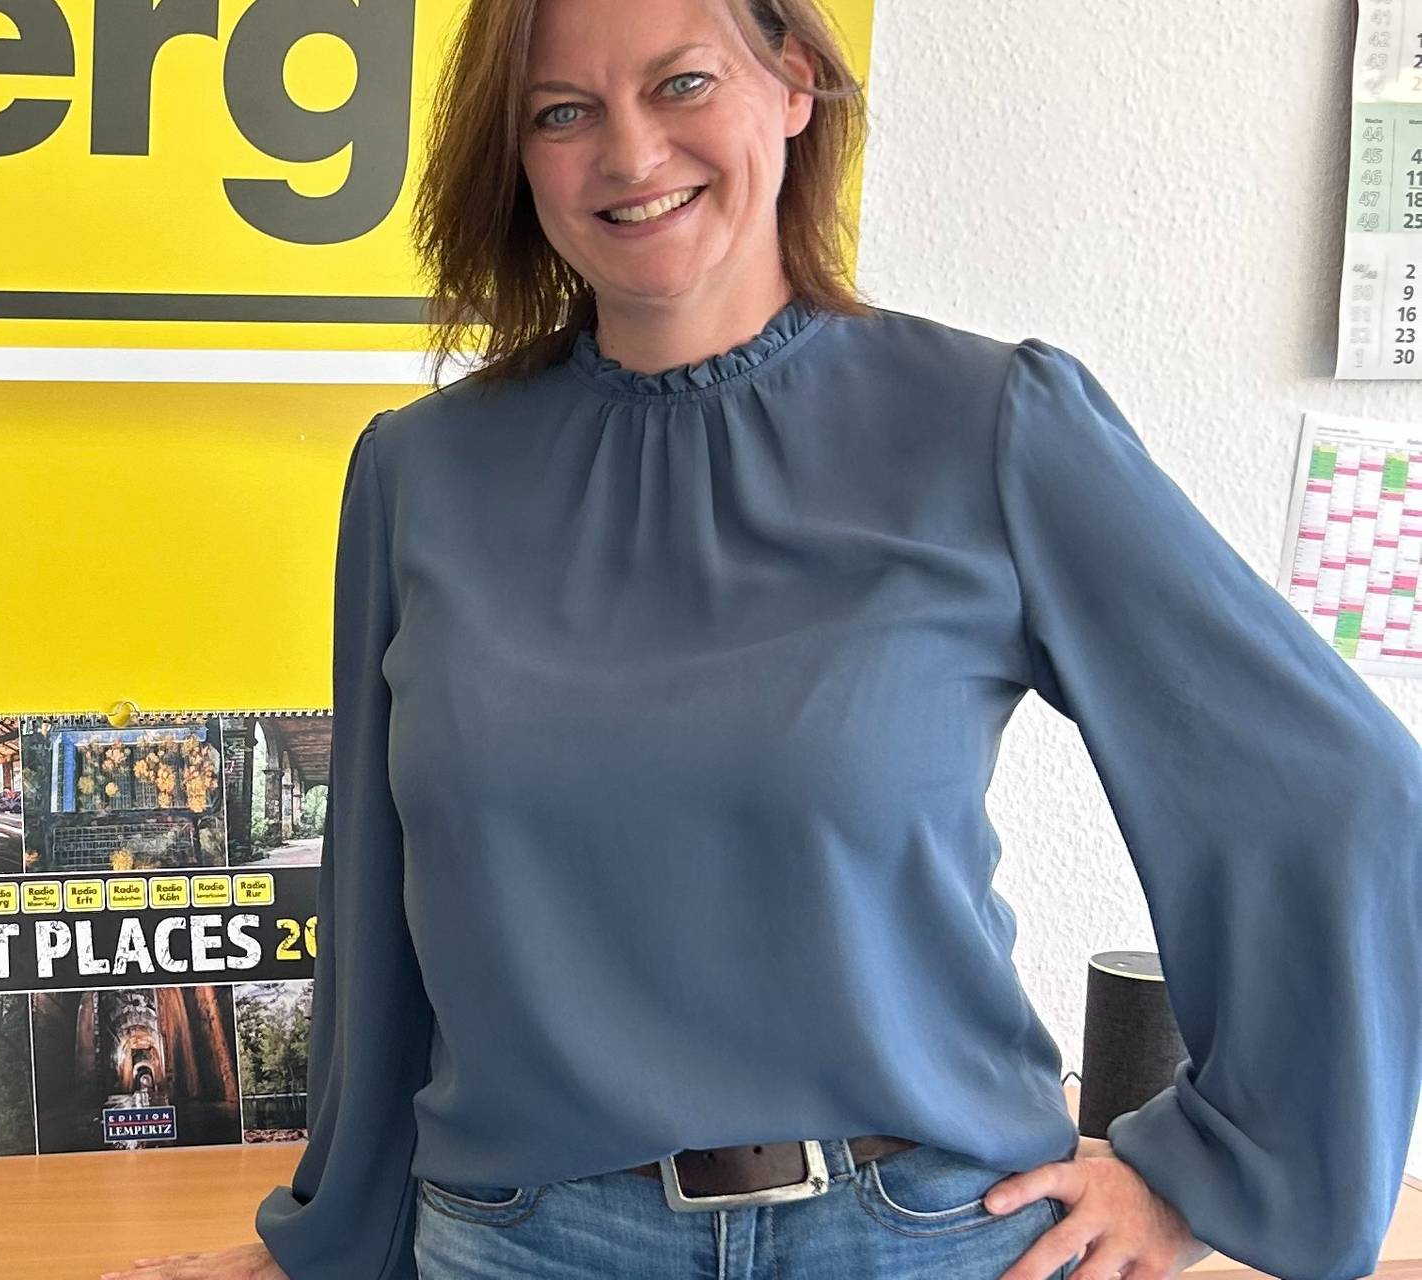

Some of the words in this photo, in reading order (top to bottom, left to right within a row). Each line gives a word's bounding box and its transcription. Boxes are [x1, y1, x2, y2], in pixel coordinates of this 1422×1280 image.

[1362, 126, 1384, 142] 44
[1362, 148, 1383, 164] 45
[1361, 169, 1382, 185] 46
[1358, 191, 1380, 207] 47
[1357, 213, 1379, 229] 48
[1405, 264, 1416, 279] 2
[1403, 285, 1414, 301] 9
[1397, 306, 1416, 322] 16
[1395, 328, 1416, 343] 23
[1393, 349, 1415, 364] 30
[28, 886, 54, 896] Radio
[71, 886, 97, 895] Radio
[114, 884, 140, 894] Radio
[156, 883, 182, 892] Radio
[198, 881, 225, 891] Radio
[241, 880, 266, 890] Radio
[76, 896, 93, 905] Erft
[159, 893, 179, 901] Köln
[246, 890, 262, 898] Rur
[35, 914, 262, 979] PLACES
[108, 1112, 170, 1122] EDITION
[109, 1123, 172, 1137] LEMPERTZ
